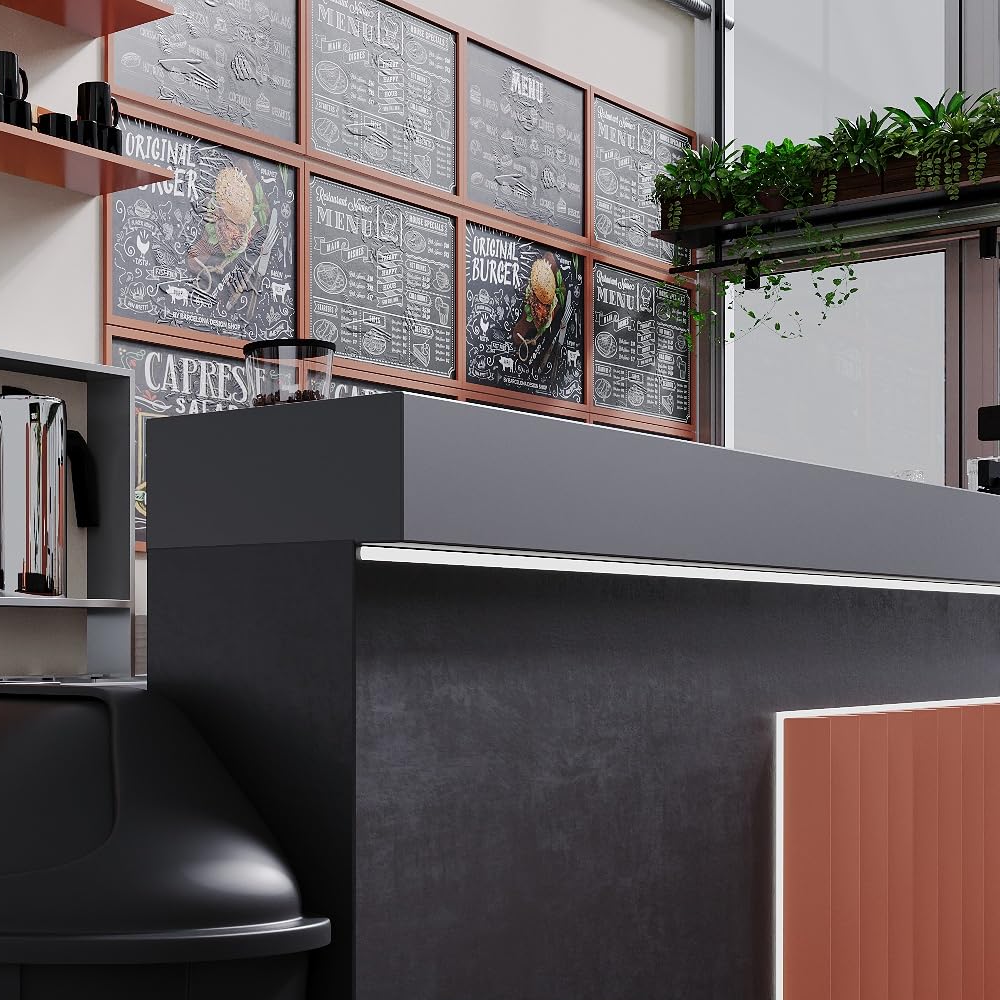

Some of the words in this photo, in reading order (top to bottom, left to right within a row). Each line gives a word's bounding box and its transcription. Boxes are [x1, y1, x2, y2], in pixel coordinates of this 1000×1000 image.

[318, 4, 373, 41] MENU
[511, 70, 544, 104] MENU
[126, 132, 196, 168] ORIGINAL
[598, 121, 636, 150] MENU
[316, 206, 372, 237] MENU
[473, 236, 519, 261] ORIGINAL
[472, 257, 520, 289] BURGER
[597, 285, 635, 310] MENU
